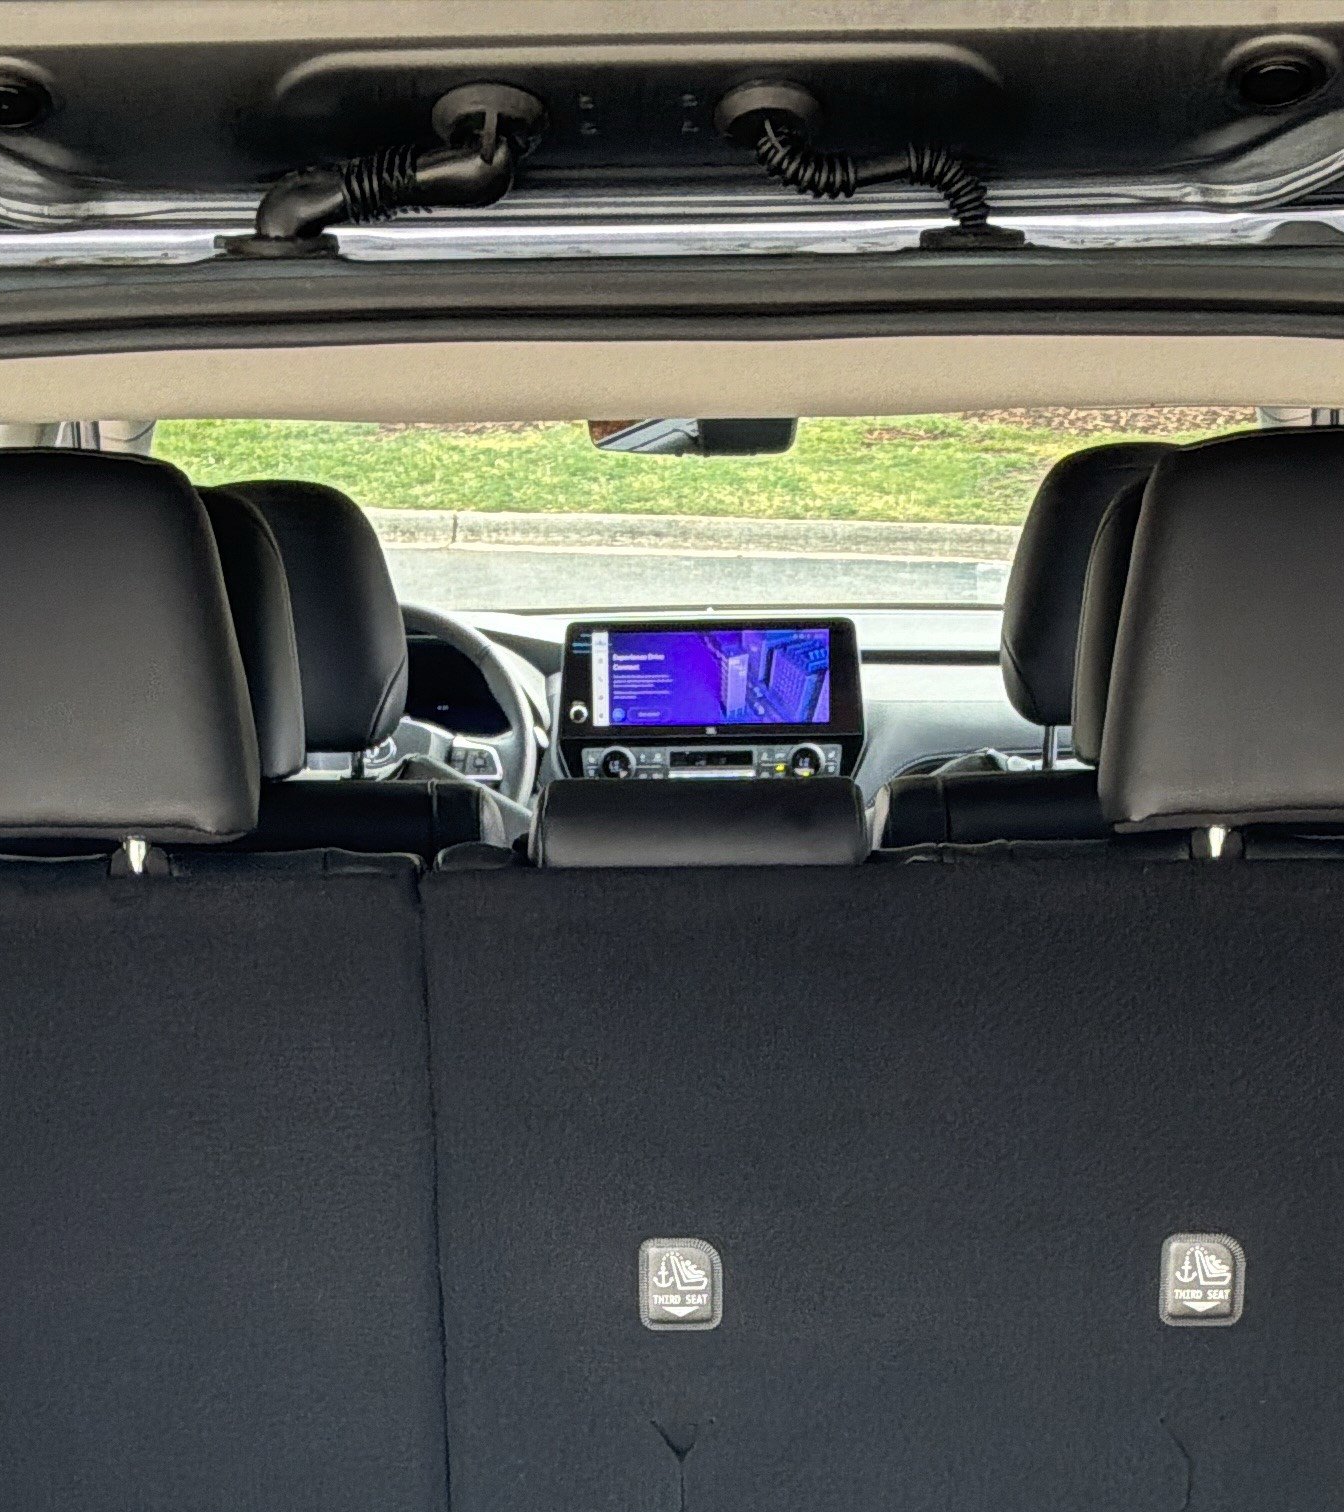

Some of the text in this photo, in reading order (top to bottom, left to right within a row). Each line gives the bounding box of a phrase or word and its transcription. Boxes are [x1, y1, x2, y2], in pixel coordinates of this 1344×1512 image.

[652, 1293, 708, 1305] THIRD SEAT
[1173, 1289, 1231, 1300] THIRD SEAT
